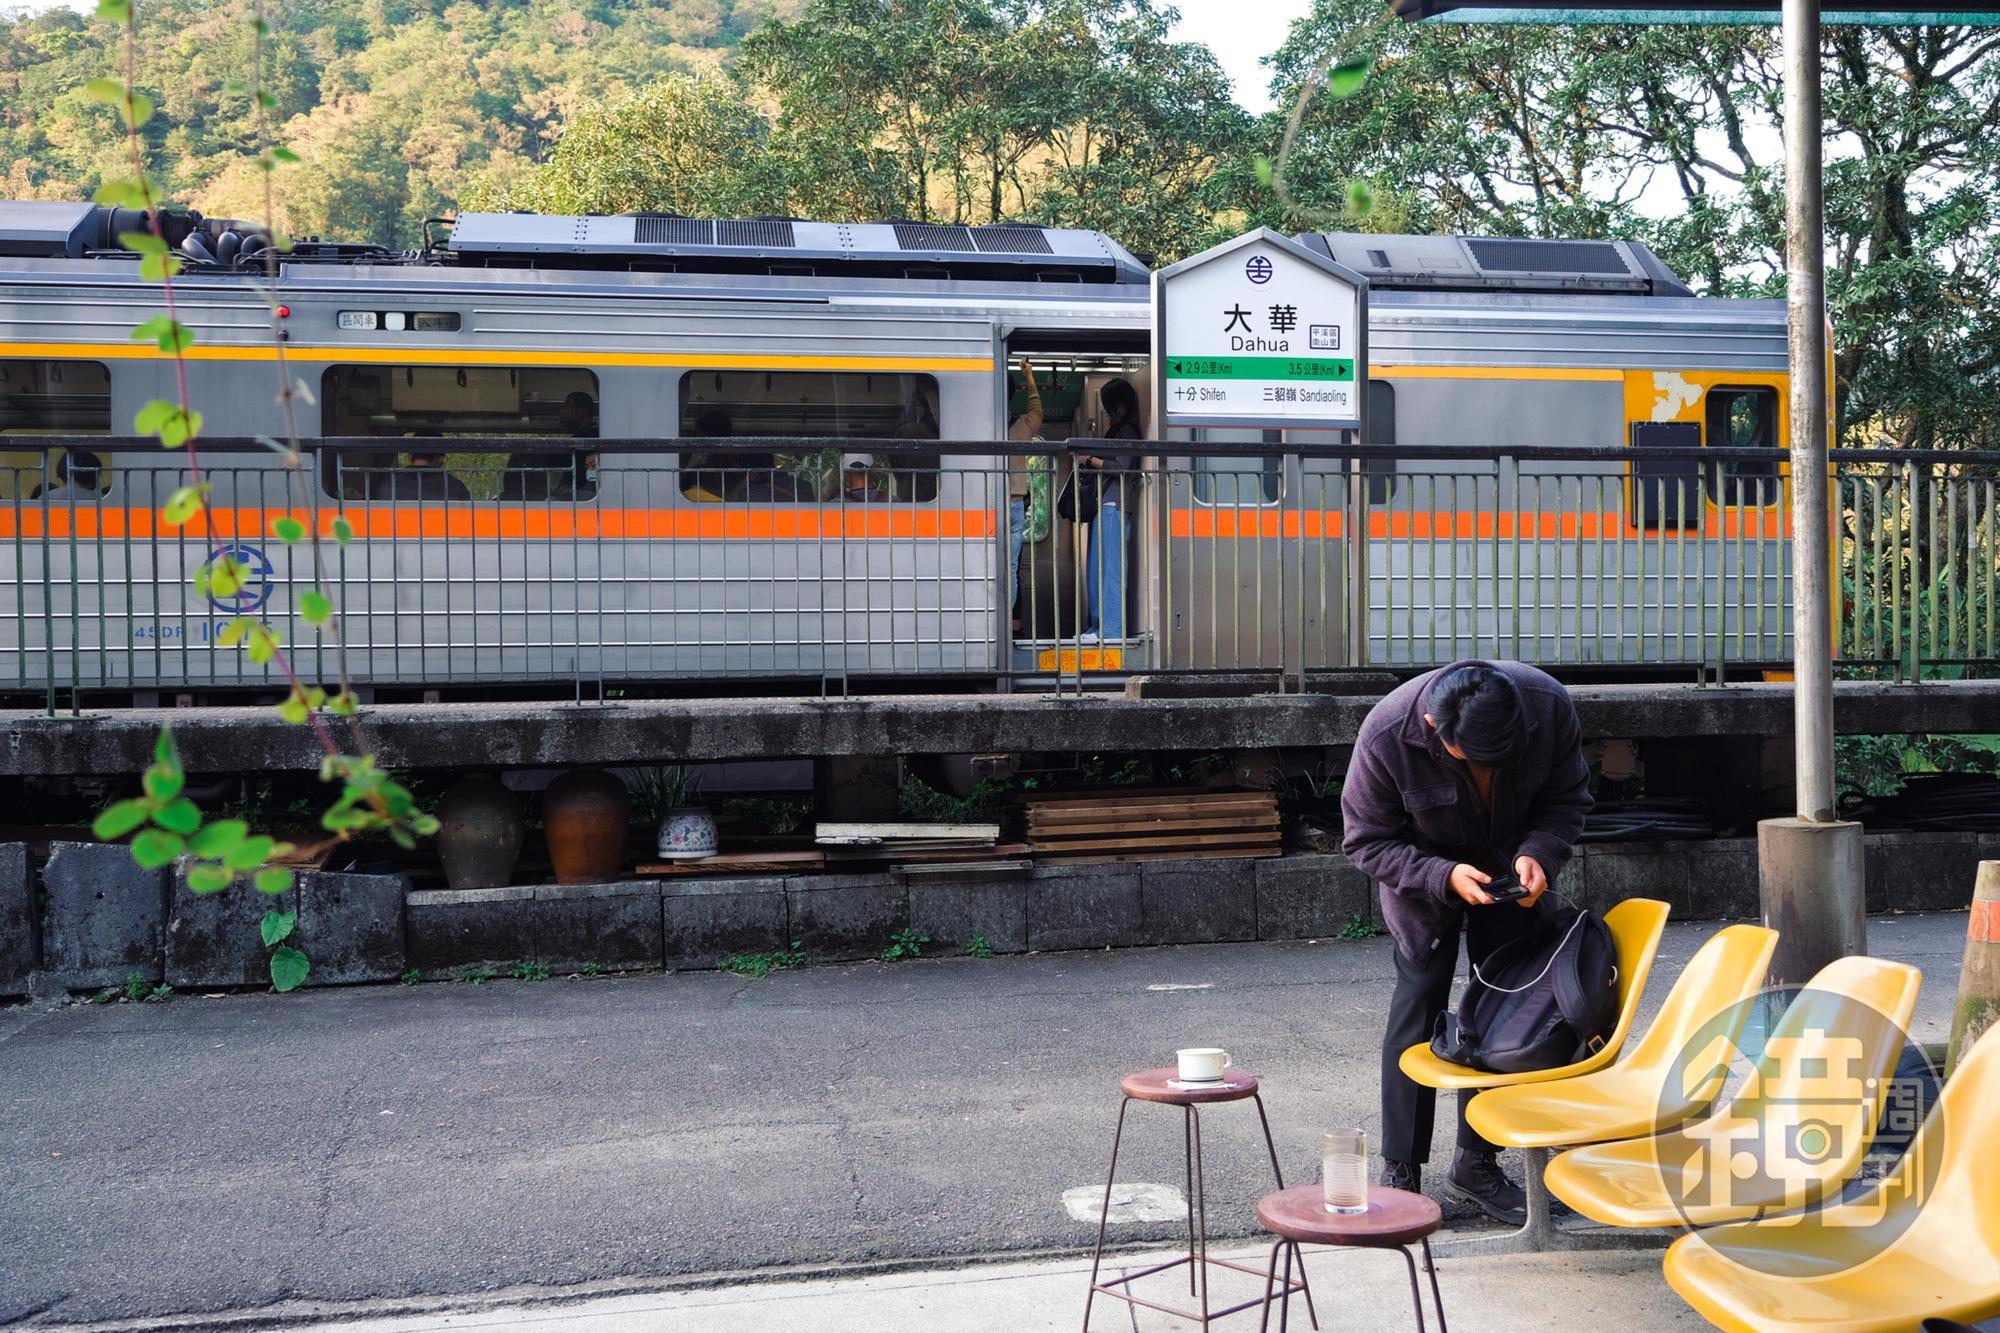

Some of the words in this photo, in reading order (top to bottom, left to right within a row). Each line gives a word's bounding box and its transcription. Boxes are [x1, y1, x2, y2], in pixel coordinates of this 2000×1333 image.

[342, 313, 375, 327] 區間車
[1223, 303, 1298, 334] 大華
[1312, 328, 1337, 338] 平溪區
[1231, 336, 1289, 352] Dahua
[1312, 338, 1337, 347] 南山里
[1174, 386, 1197, 401] 十分
[1199, 386, 1226, 401] Shifen
[1262, 387, 1297, 402] 三貂嶺
[1299, 388, 1347, 406] Sandiaoling
